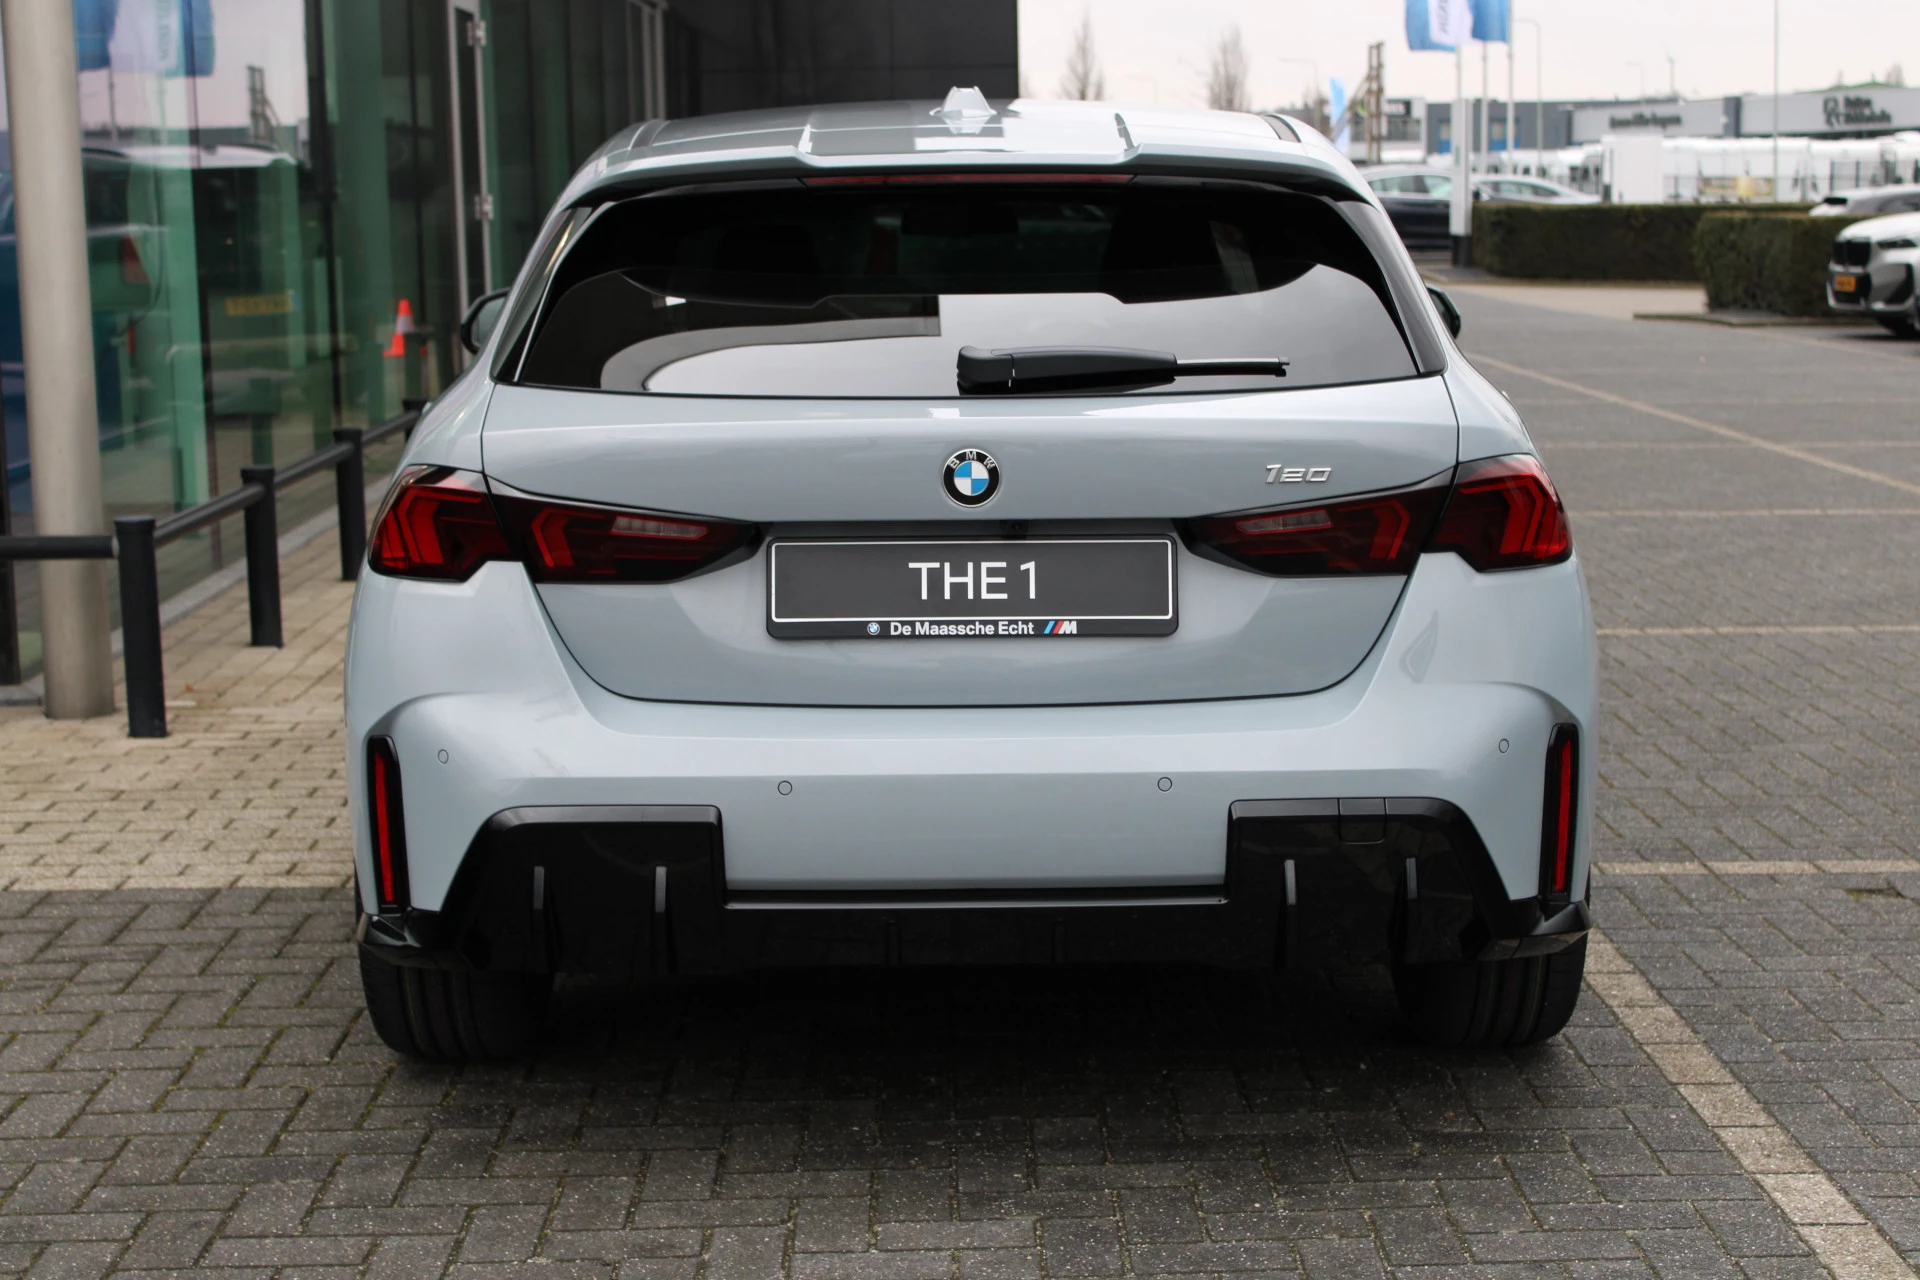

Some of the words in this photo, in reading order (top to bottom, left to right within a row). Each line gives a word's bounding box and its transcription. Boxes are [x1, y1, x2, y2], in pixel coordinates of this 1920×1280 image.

[947, 451, 996, 469] BMW
[1266, 464, 1332, 482] 120
[908, 561, 1009, 600] THE
[1020, 560, 1037, 600] 1
[890, 622, 912, 636] De
[915, 621, 995, 636] Maassche
[998, 621, 1035, 635] Echt
